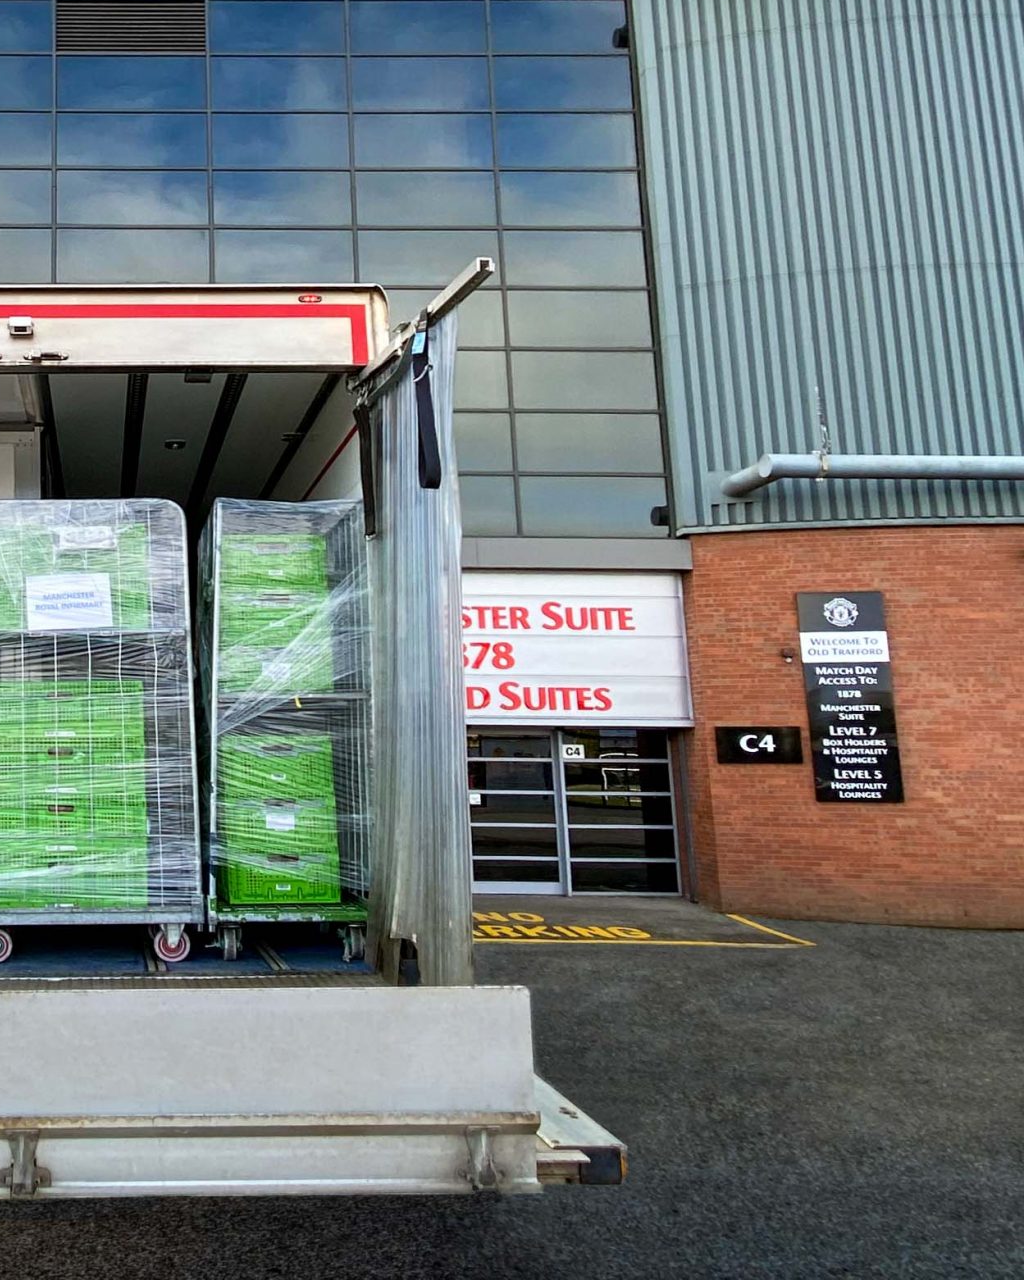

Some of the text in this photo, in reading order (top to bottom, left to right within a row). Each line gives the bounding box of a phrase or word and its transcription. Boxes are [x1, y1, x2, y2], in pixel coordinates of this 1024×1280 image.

[540, 601, 636, 631] SUITE
[809, 637, 862, 646] WELCOME
[807, 647, 884, 656] OLD TRAFFORD
[815, 666, 878, 675] MATCH DAY
[818, 676, 857, 685] ACCESS
[498, 681, 613, 711] SUITES
[820, 704, 881, 712] MANCHESTER
[838, 713, 865, 721] SUITE
[829, 726, 877, 736] LEVEL 7
[739, 734, 776, 753] C4
[823, 738, 887, 747] BOX HOLDERS
[565, 746, 581, 757] C4
[831, 747, 888, 756] HOSPITALITY
[835, 756, 878, 764] LOUNGES
[834, 769, 872, 779] LEVEL
[831, 781, 888, 790] HOSPITALITY
[839, 790, 882, 799] LOUNGES
